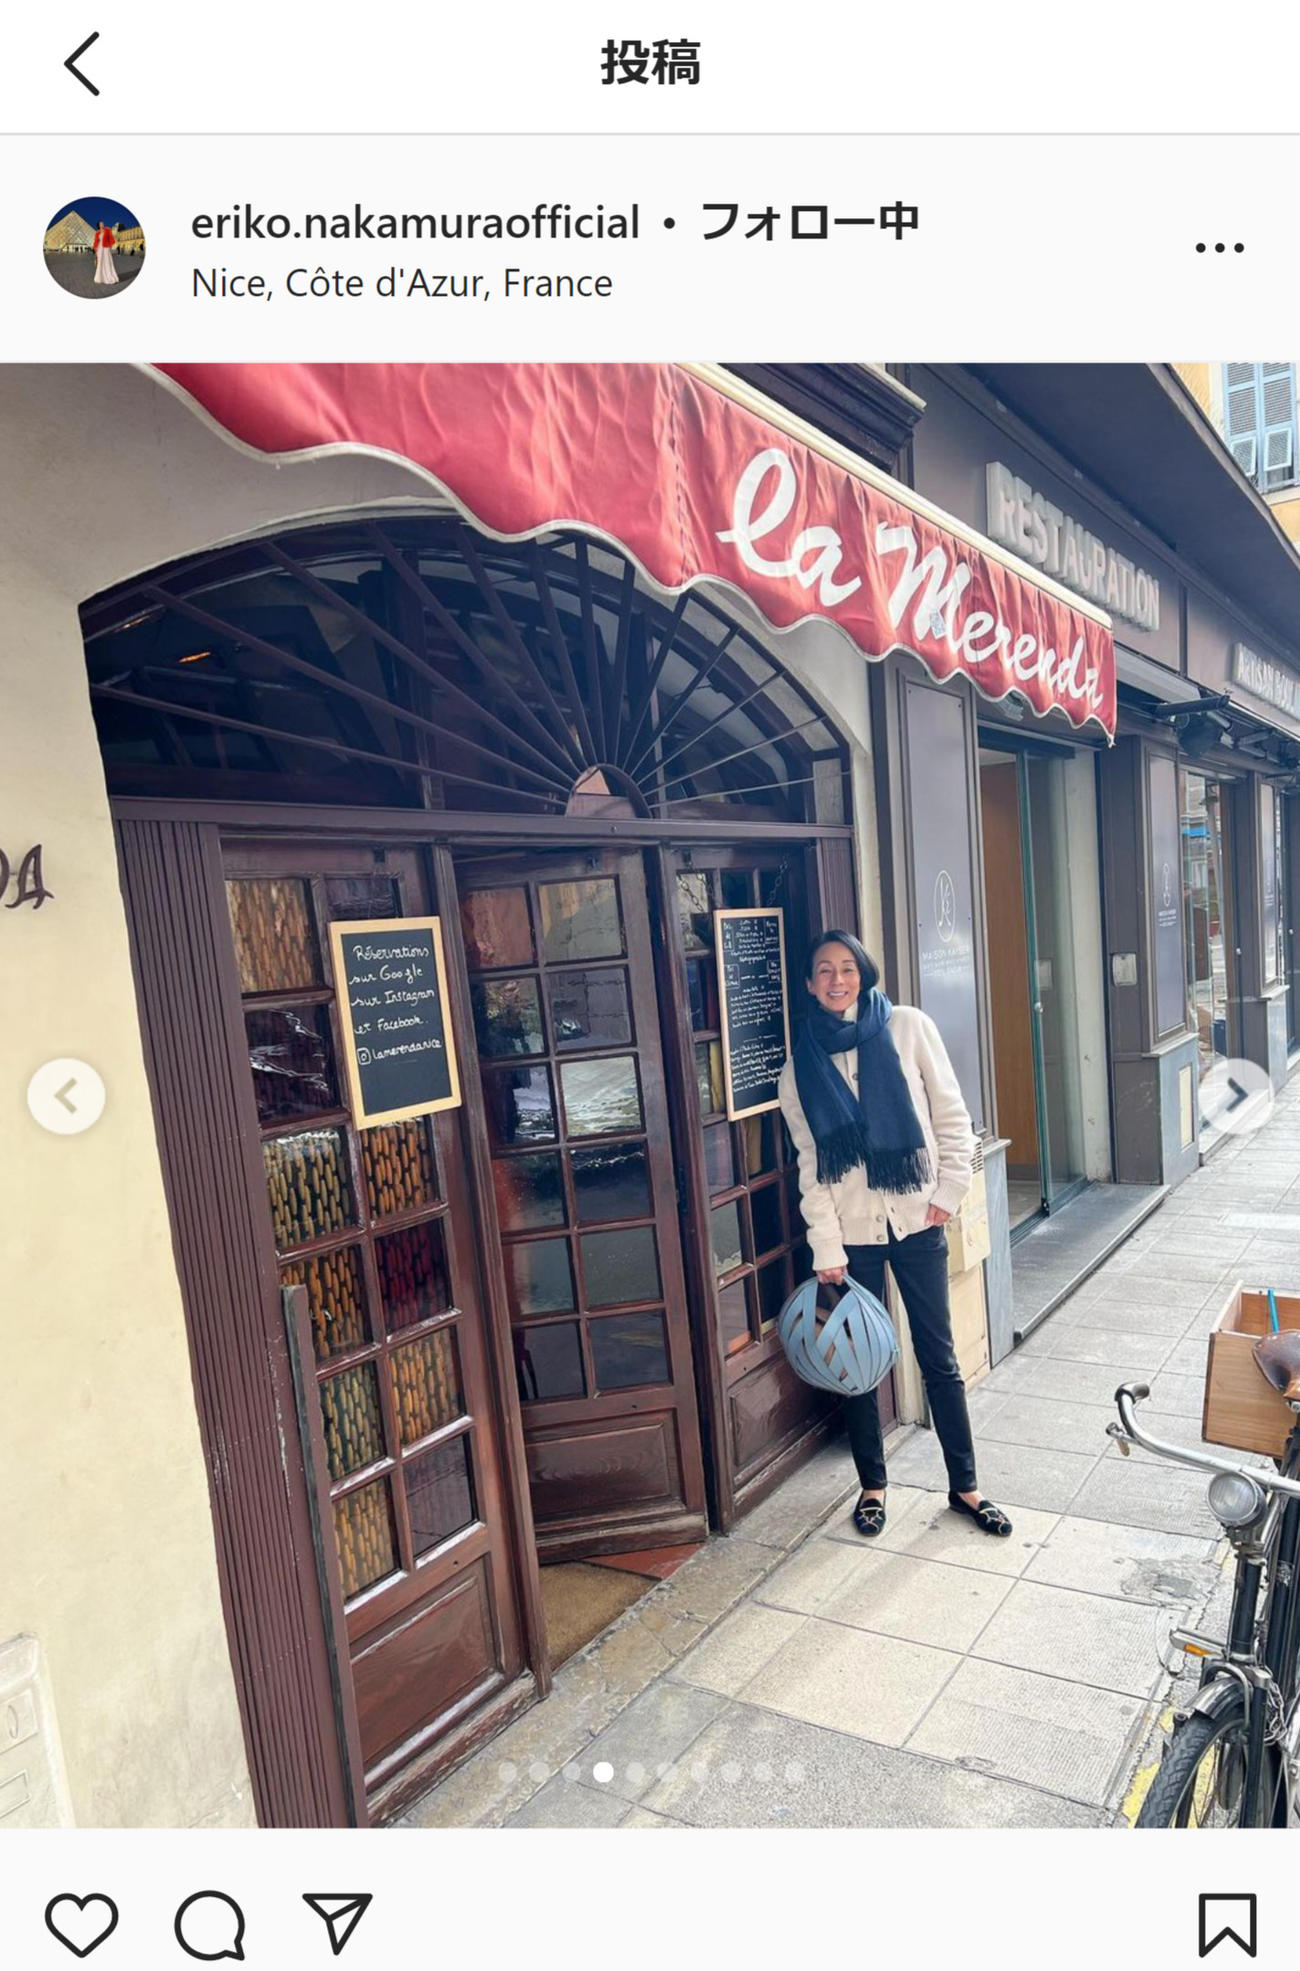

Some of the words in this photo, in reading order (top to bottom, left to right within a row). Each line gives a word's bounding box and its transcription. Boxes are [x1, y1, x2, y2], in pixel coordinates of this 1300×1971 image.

[986, 461, 1160, 632] RESTAURATION
[874, 521, 1103, 709] Merenda
[353, 944, 430, 961] Réservations
[349, 973, 377, 985] sur
[379, 963, 423, 985] Google
[351, 995, 381, 1007] sur
